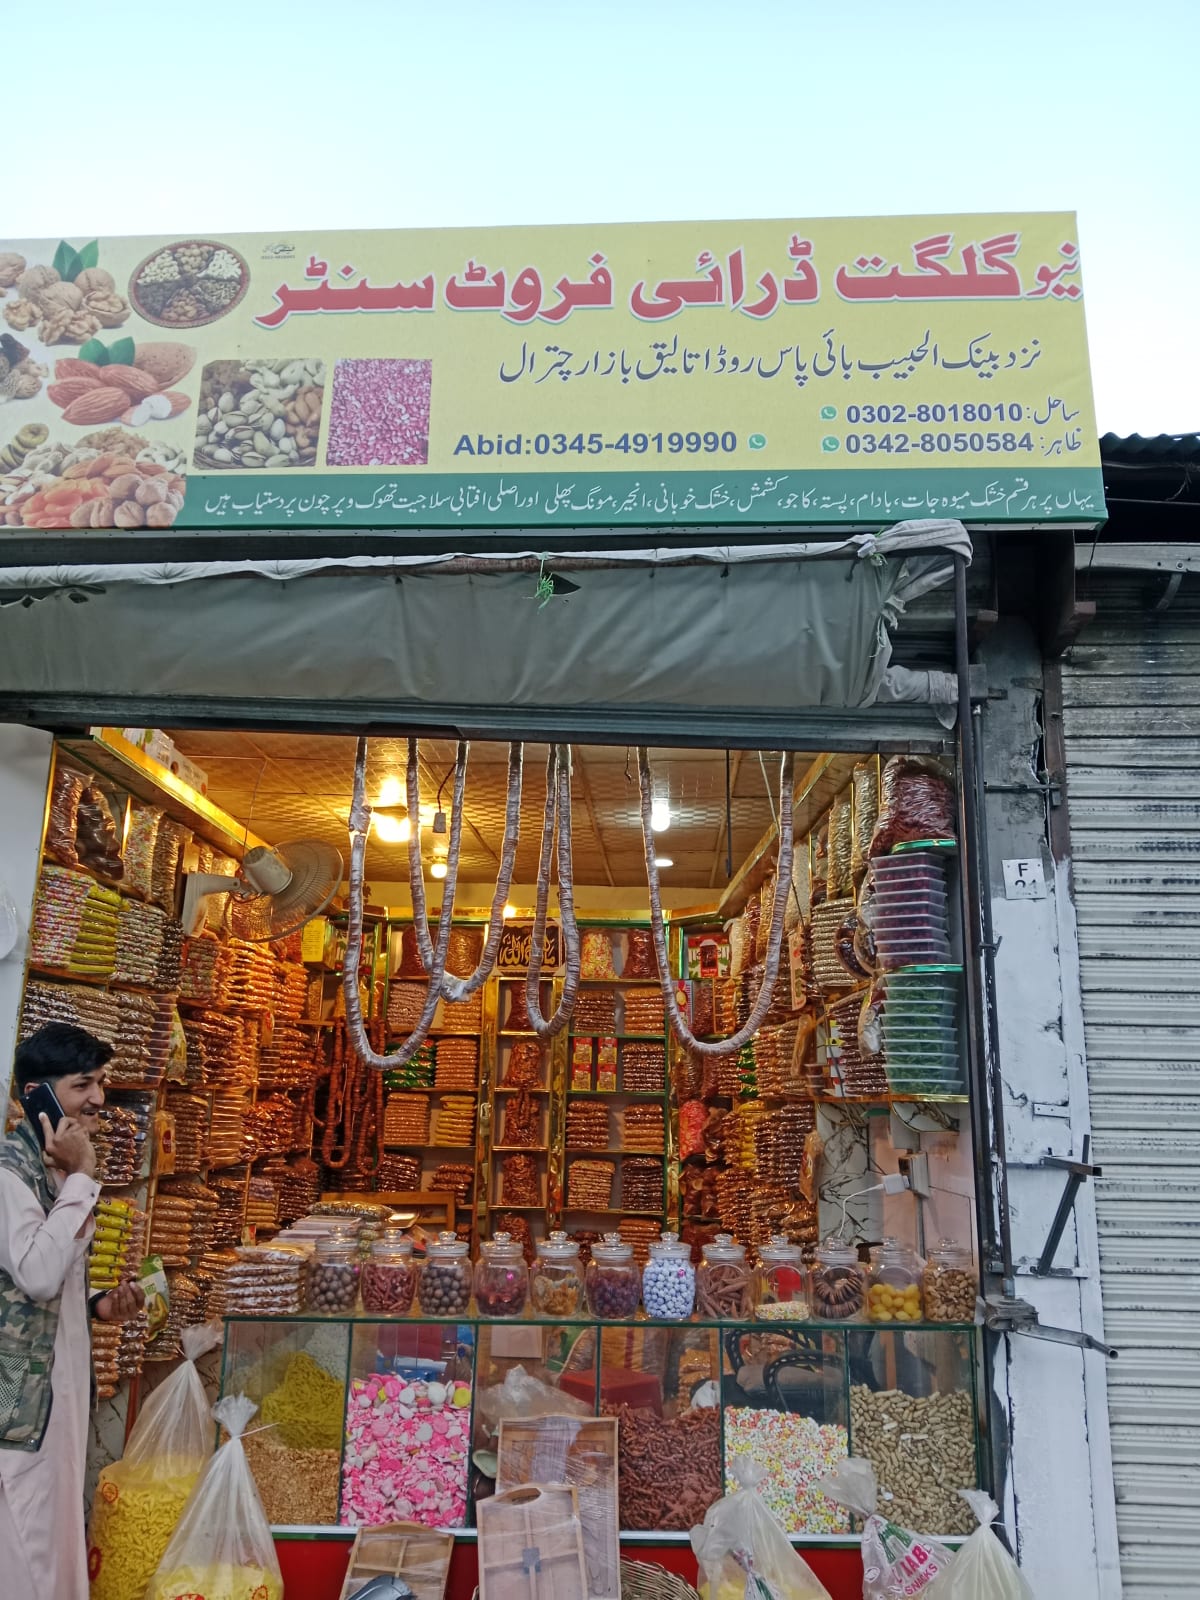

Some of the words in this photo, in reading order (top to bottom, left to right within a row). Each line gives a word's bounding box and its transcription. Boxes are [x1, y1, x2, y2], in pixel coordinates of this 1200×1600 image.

[630, 235, 818, 320] ڈرائی
[835, 231, 1021, 300] گلگت
[1025, 242, 1082, 298] نیو
[253, 255, 436, 328] سنٹر
[445, 250, 613, 322] فروٹ
[498, 341, 575, 384] چترال
[574, 349, 632, 384] بازار
[635, 333, 711, 382] اتالیق
[713, 344, 755, 374] روڈ
[757, 344, 810, 388] پاس
[856, 328, 939, 380] الحبیب
[941, 332, 1000, 380] بینک
[1003, 338, 1042, 369] نزد
[846, 402, 1024, 424] 0302-8018010
[845, 432, 1035, 455] 0342-8050584
[204, 492, 231, 516] ہیں
[232, 491, 284, 515] دستیاب
[283, 496, 297, 517] پر
[355, 482, 398, 510] تھوک
[487, 479, 518, 511] اصلی
[517, 491, 539, 508] اور
[545, 482, 575, 514] پھلی
[570, 485, 613, 511] مونگ
[695, 484, 730, 509] خشک
[942, 490, 970, 508] میوہ
[970, 481, 1006, 507] خشک
[1006, 477, 1029, 515] قسم
[1021, 494, 1038, 512] ہر
[1039, 494, 1054, 514] پر
[1055, 489, 1095, 511] یہاں
[1018, 862, 1029, 877] F
